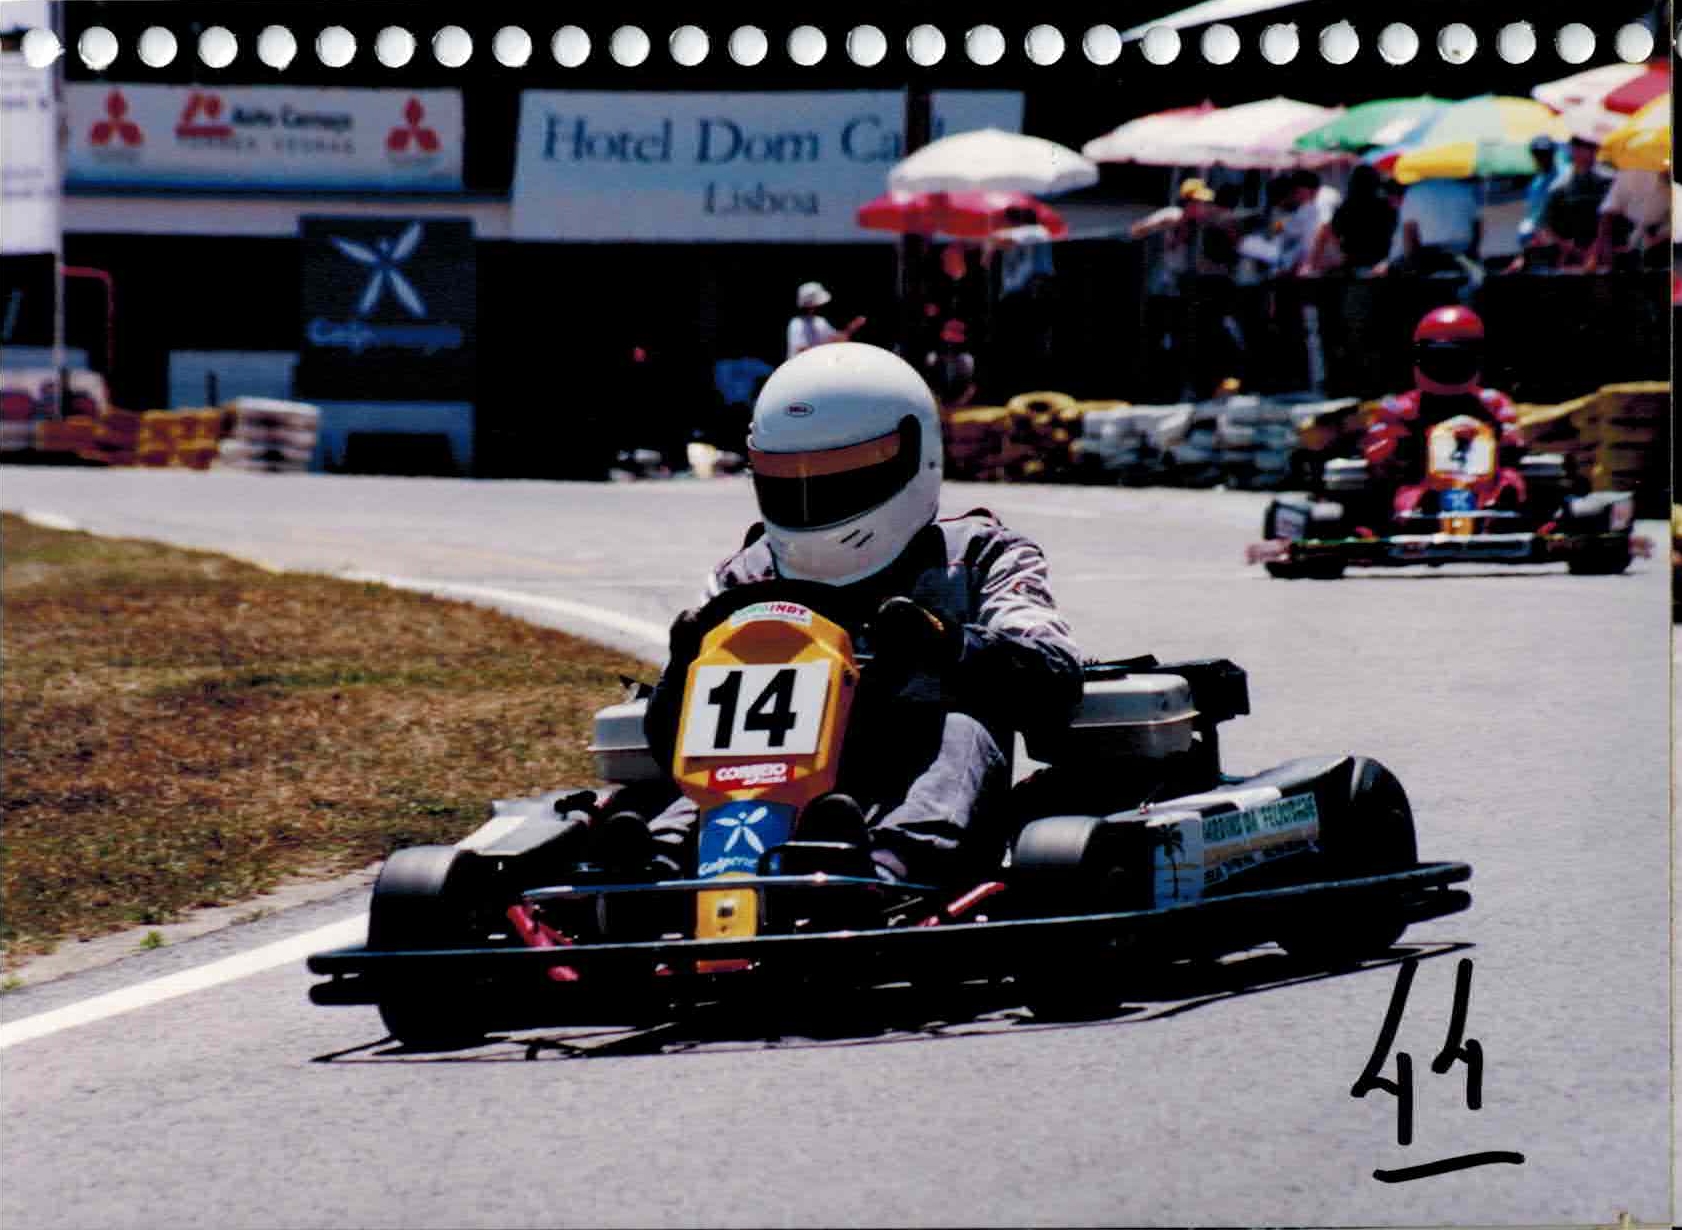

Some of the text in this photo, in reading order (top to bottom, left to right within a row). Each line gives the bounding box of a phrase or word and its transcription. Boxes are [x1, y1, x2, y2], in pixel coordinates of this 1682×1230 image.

[543, 113, 674, 165] Hotel
[697, 113, 821, 165] Dom
[704, 180, 820, 217] Lisboa
[707, 667, 798, 750] 14
